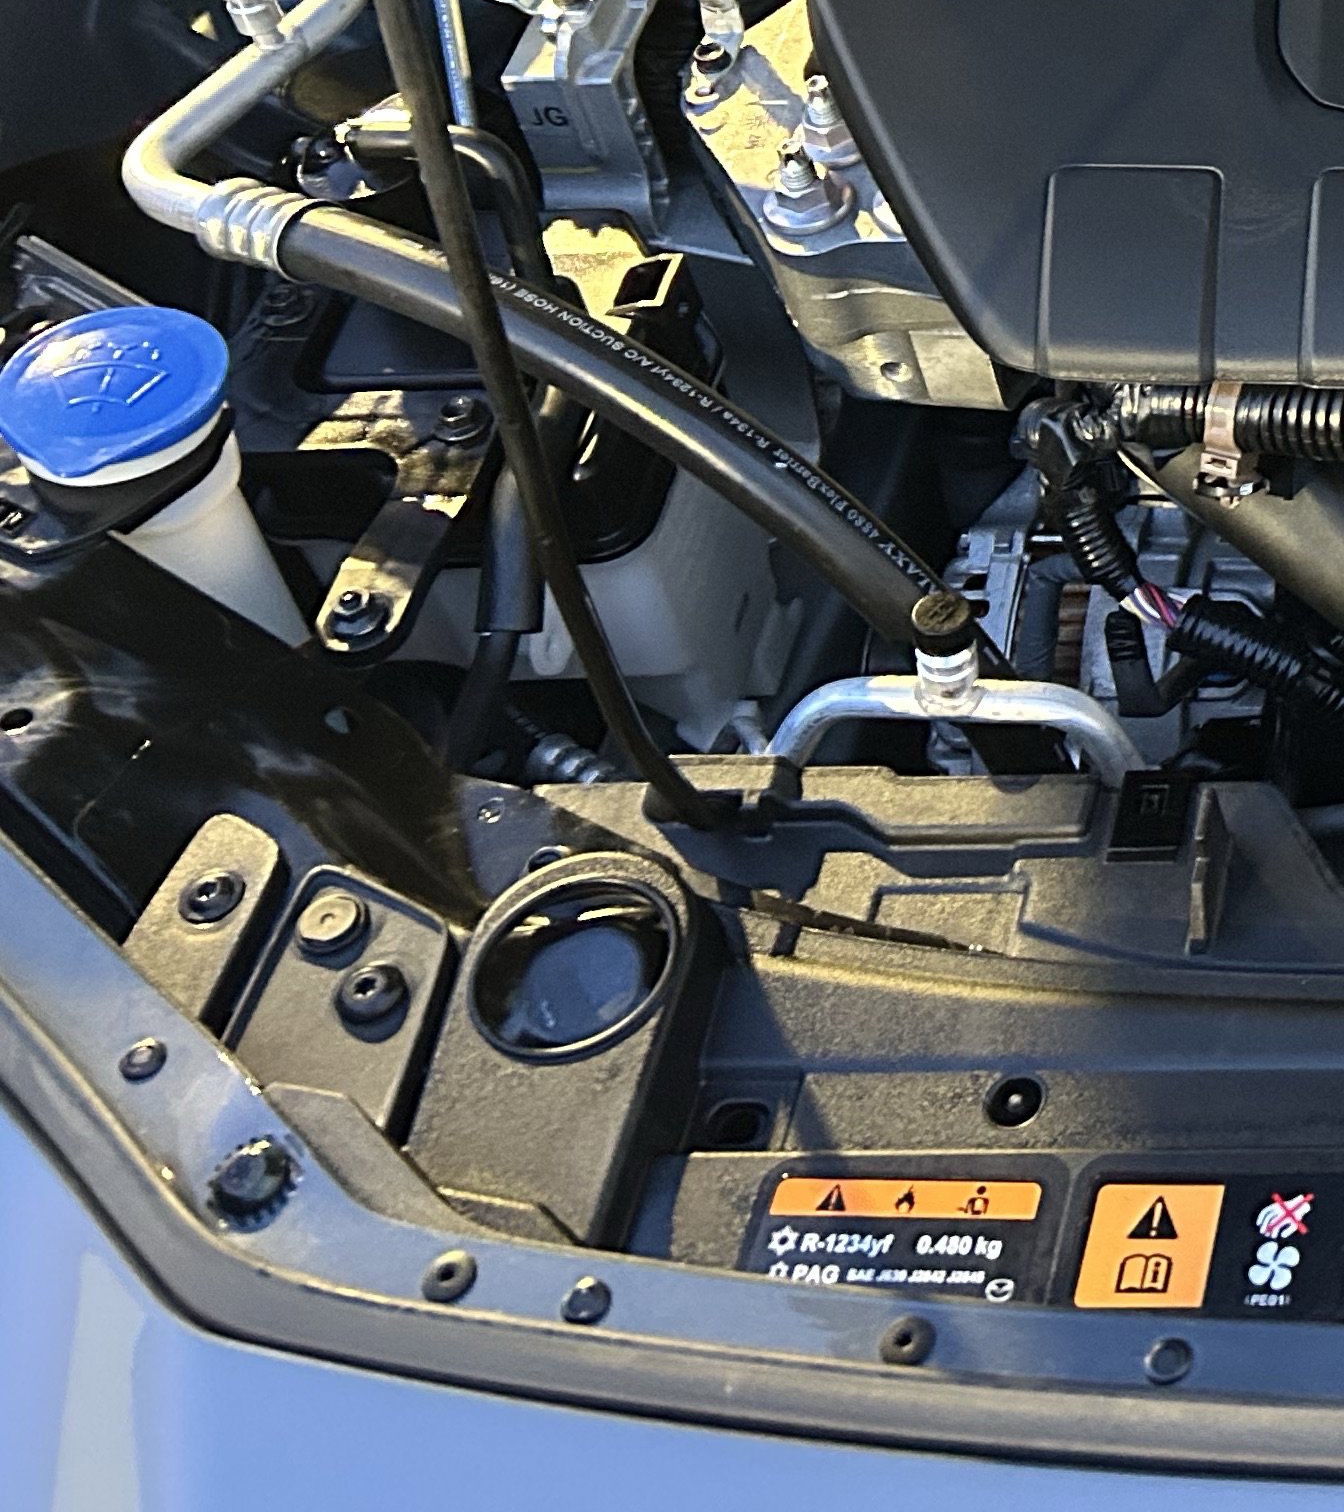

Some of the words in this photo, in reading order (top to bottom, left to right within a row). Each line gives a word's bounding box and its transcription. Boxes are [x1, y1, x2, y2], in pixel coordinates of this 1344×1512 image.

[531, 106, 568, 126] JG
[513, 289, 559, 314] HOSE
[557, 310, 625, 351] SUCTION
[800, 1233, 895, 1258] R-1234yf
[974, 1235, 1003, 1260] kg
[792, 1264, 840, 1285] PAG
